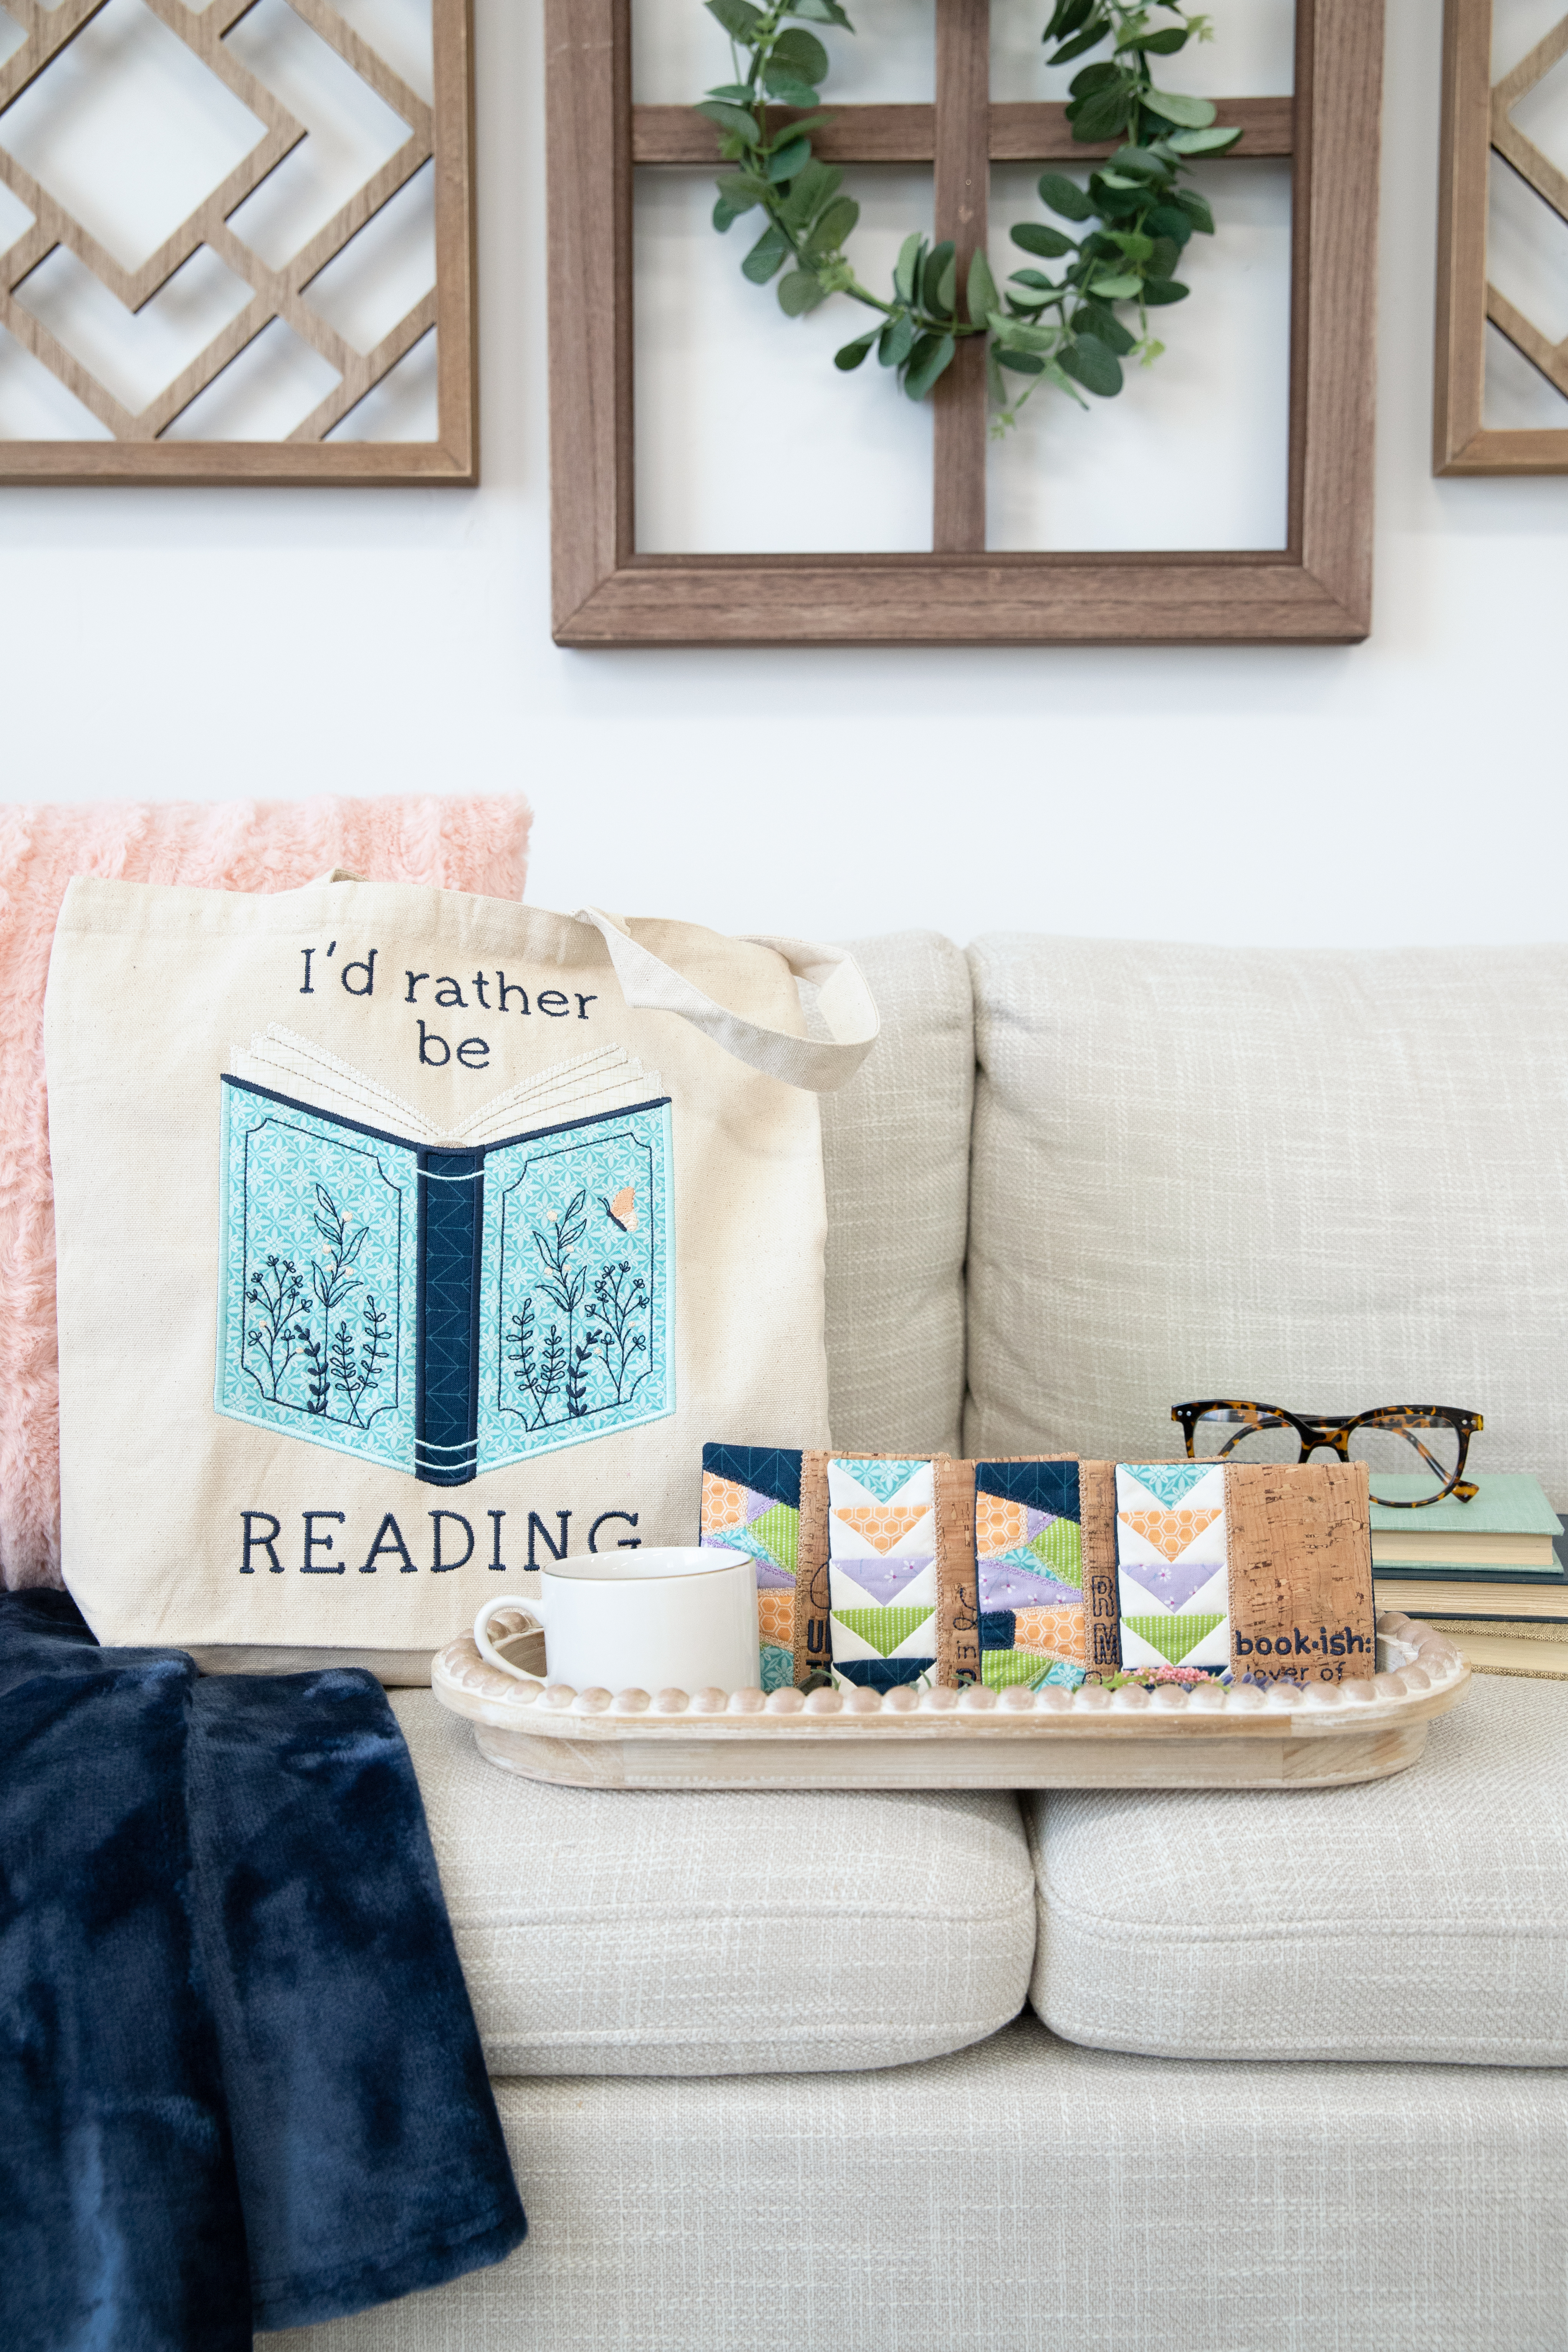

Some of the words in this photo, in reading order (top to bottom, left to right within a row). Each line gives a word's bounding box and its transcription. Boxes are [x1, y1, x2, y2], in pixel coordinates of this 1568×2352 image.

[300, 941, 378, 996] I'd
[405, 971, 598, 1020] rather
[416, 1019, 490, 1069] be
[239, 1510, 642, 1574] READING
[1320, 1661, 1346, 1681] of
